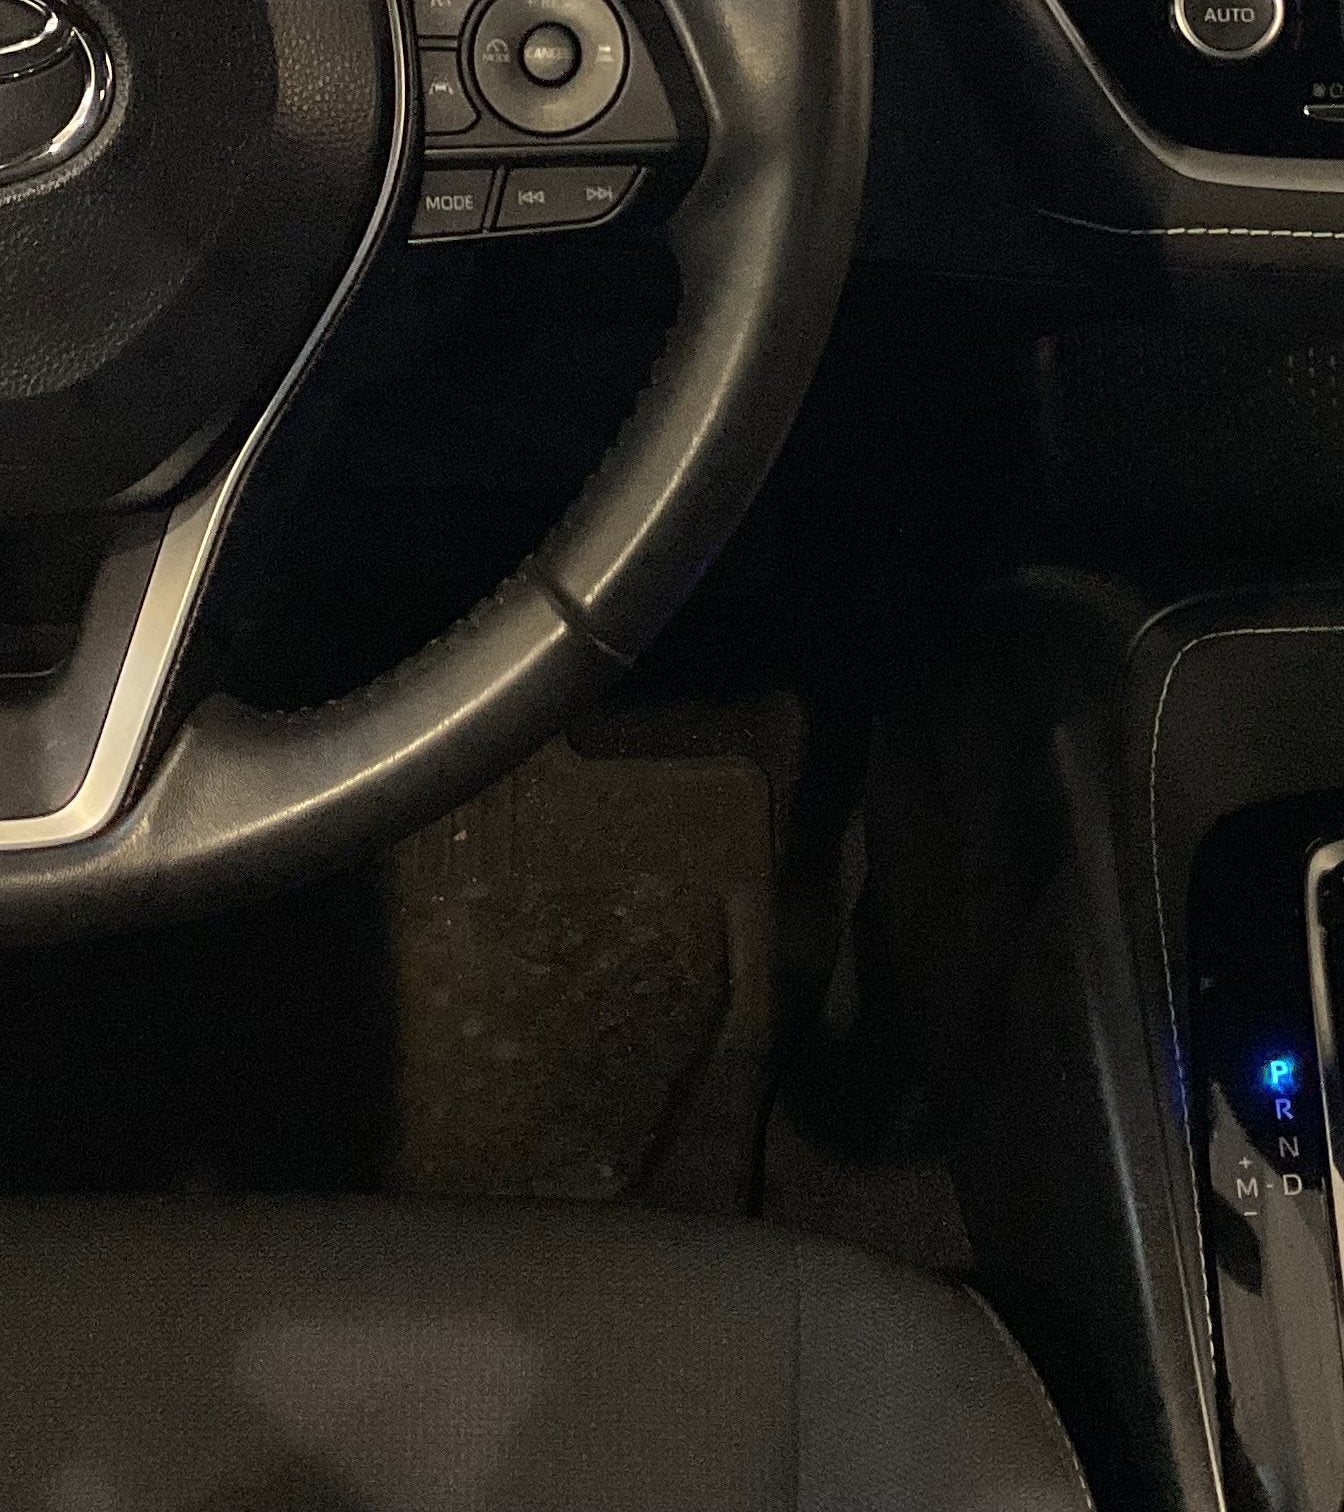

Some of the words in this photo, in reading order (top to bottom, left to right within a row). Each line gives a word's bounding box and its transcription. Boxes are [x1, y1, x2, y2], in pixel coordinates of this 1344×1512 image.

[1204, 7, 1256, 23] AUTO
[425, 194, 474, 211] MODE
[1270, 1059, 1289, 1085] P
[1275, 1097, 1295, 1121] R
[1278, 1135, 1300, 1158] N
[1235, 1176, 1260, 1200] M
[1283, 1173, 1303, 1197] D
